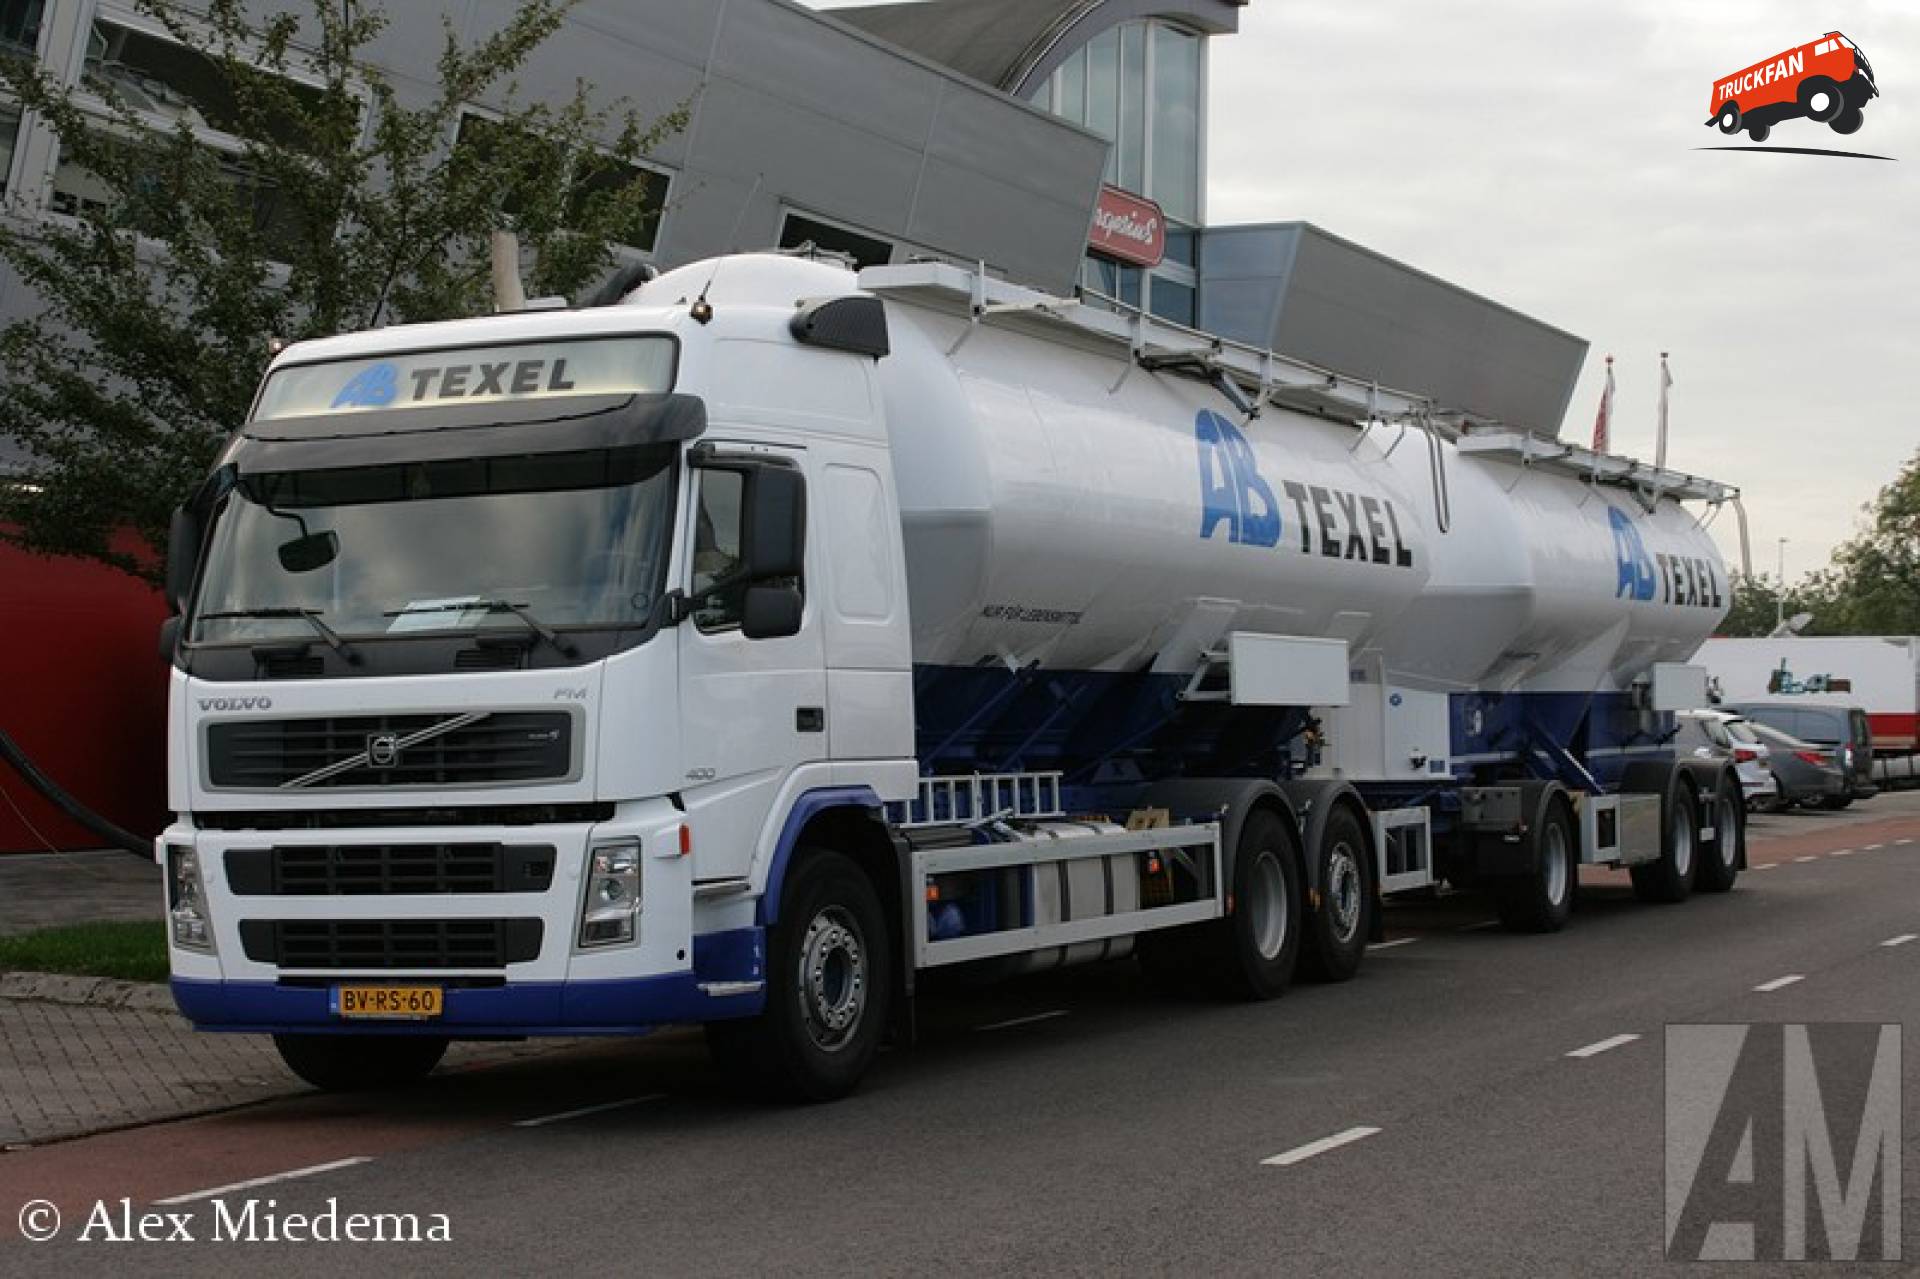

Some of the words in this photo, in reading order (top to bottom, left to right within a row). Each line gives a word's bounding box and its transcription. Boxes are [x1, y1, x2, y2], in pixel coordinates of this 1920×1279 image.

[329, 361, 398, 409] AB
[411, 358, 575, 401] TEXEL
[1195, 408, 1281, 548] AB
[1282, 479, 1412, 567] TEXEL
[1656, 553, 1721, 608] TEXEL
[198, 696, 272, 711] VOLVO
